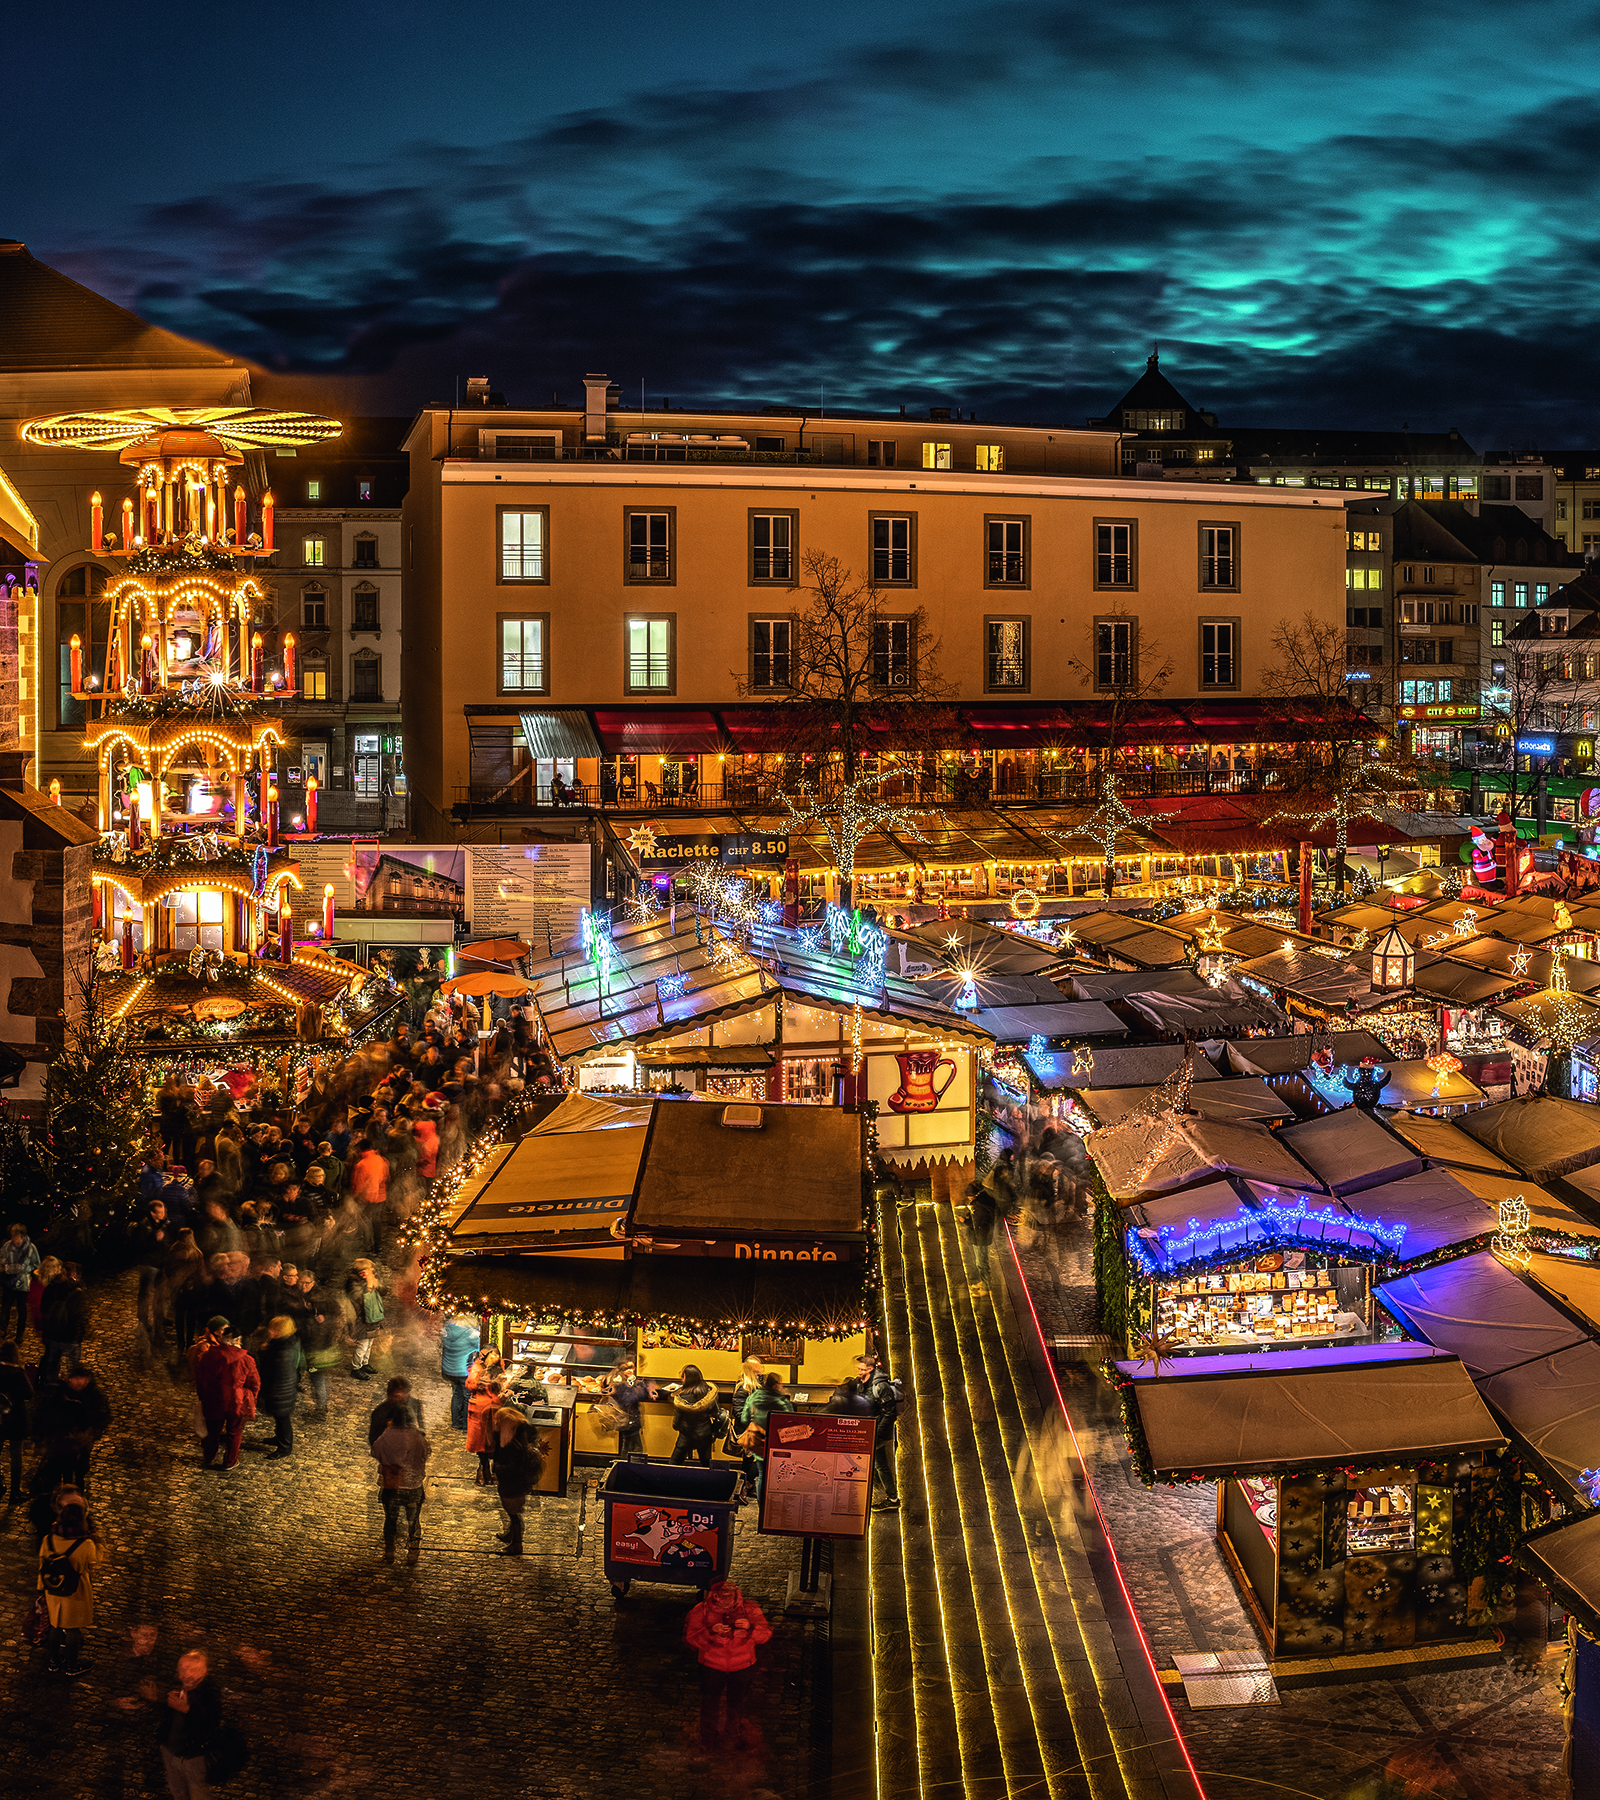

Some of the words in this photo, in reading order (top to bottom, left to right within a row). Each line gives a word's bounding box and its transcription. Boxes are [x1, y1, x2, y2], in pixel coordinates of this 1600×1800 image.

[1426, 707, 1443, 716] CITY
[1457, 706, 1477, 716] POINT
[643, 844, 720, 859] Raclette
[727, 847, 749, 856] CHF
[751, 840, 787, 855] 8.50
[507, 1198, 625, 1214] Dinnete
[735, 1243, 837, 1262] Dinnete
[692, 1513, 714, 1525] Da!
[615, 1540, 639, 1550] easy!
